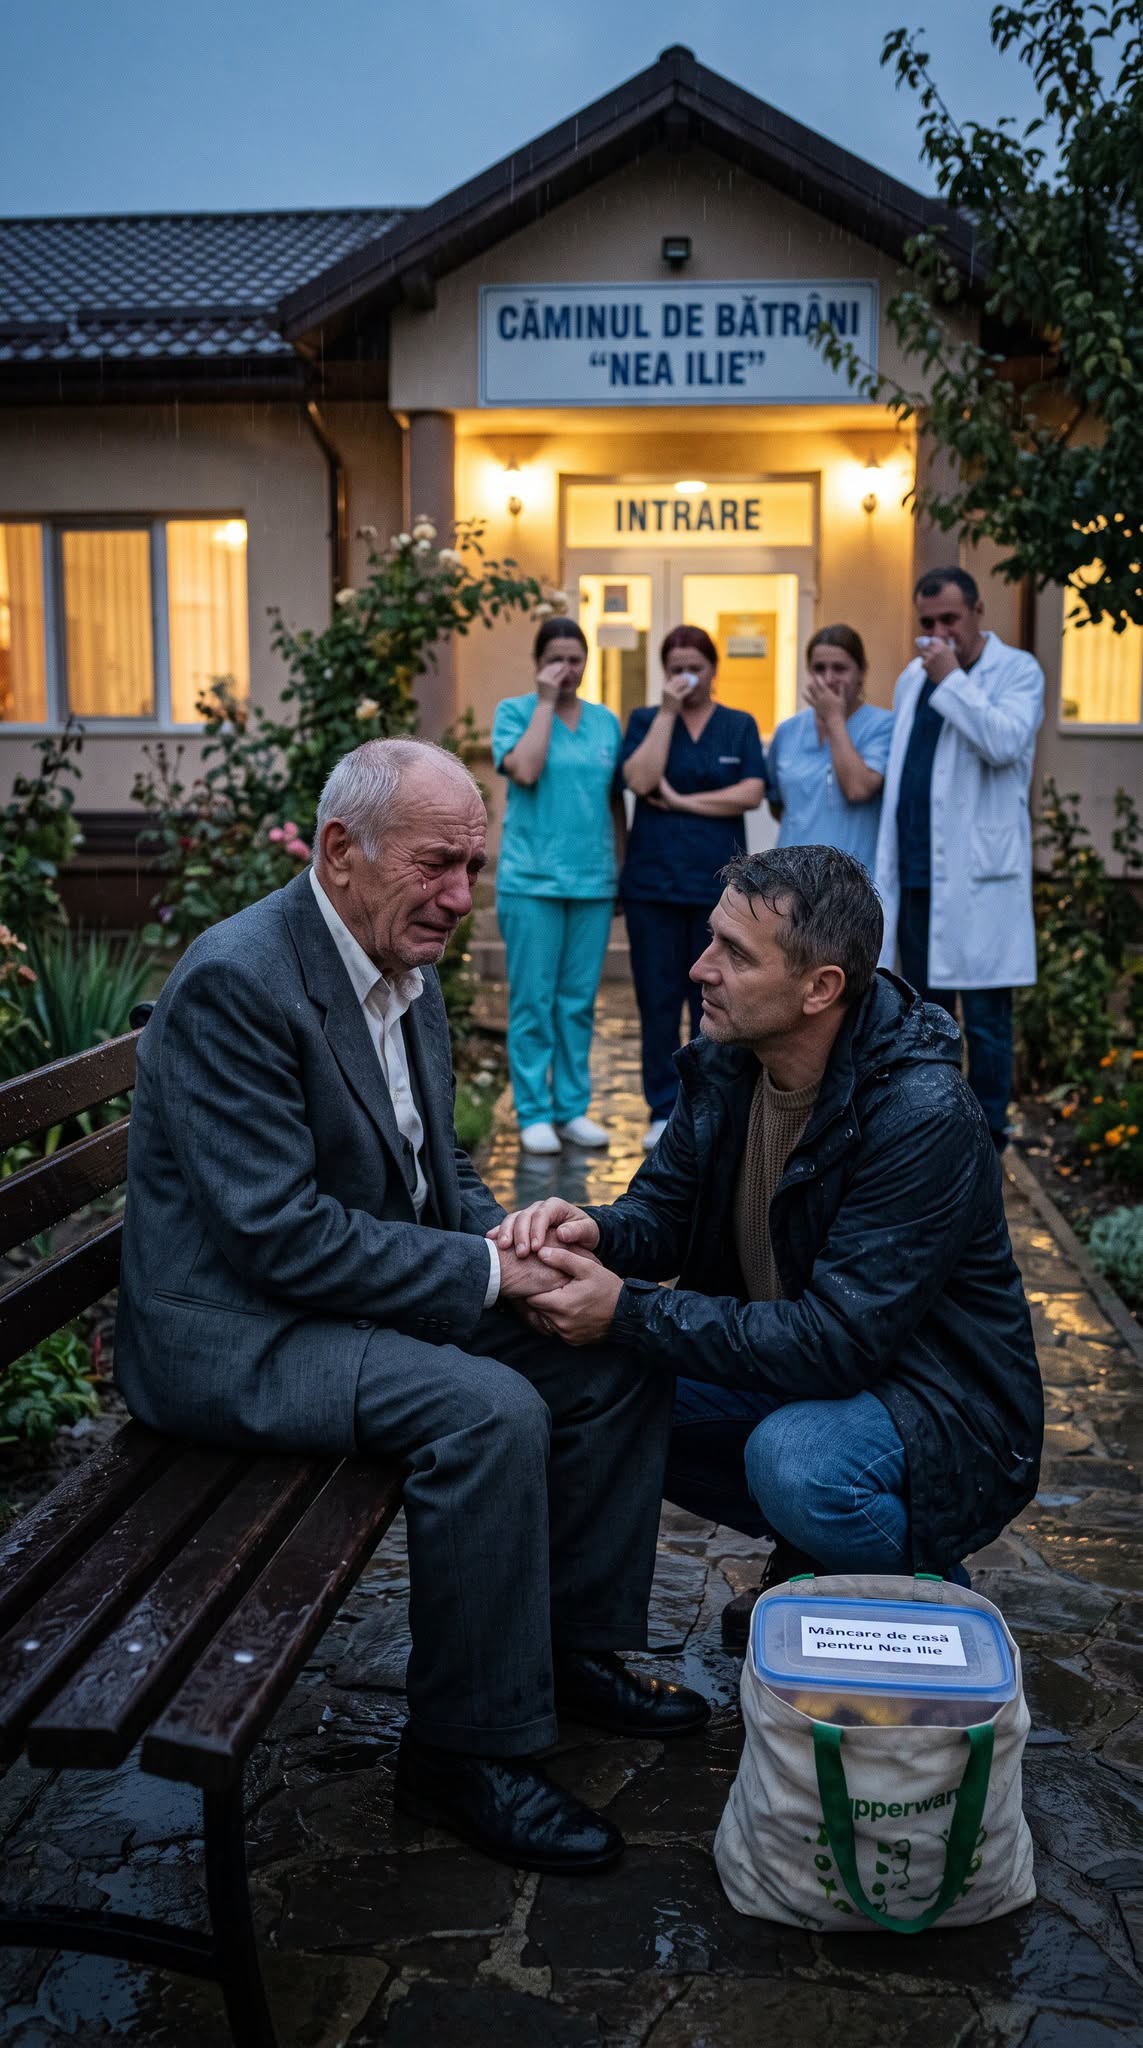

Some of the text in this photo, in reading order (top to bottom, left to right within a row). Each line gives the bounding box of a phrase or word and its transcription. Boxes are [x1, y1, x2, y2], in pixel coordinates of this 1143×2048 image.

[498, 292, 860, 341] CĂMINUL DE BĂTRÂNI
[589, 349, 766, 386] “NEA ILIE”
[616, 499, 760, 531] INTRARE
[808, 1626, 949, 1643] Mâncare de casă
[816, 1641, 943, 1656] pentru Nea Ilie
